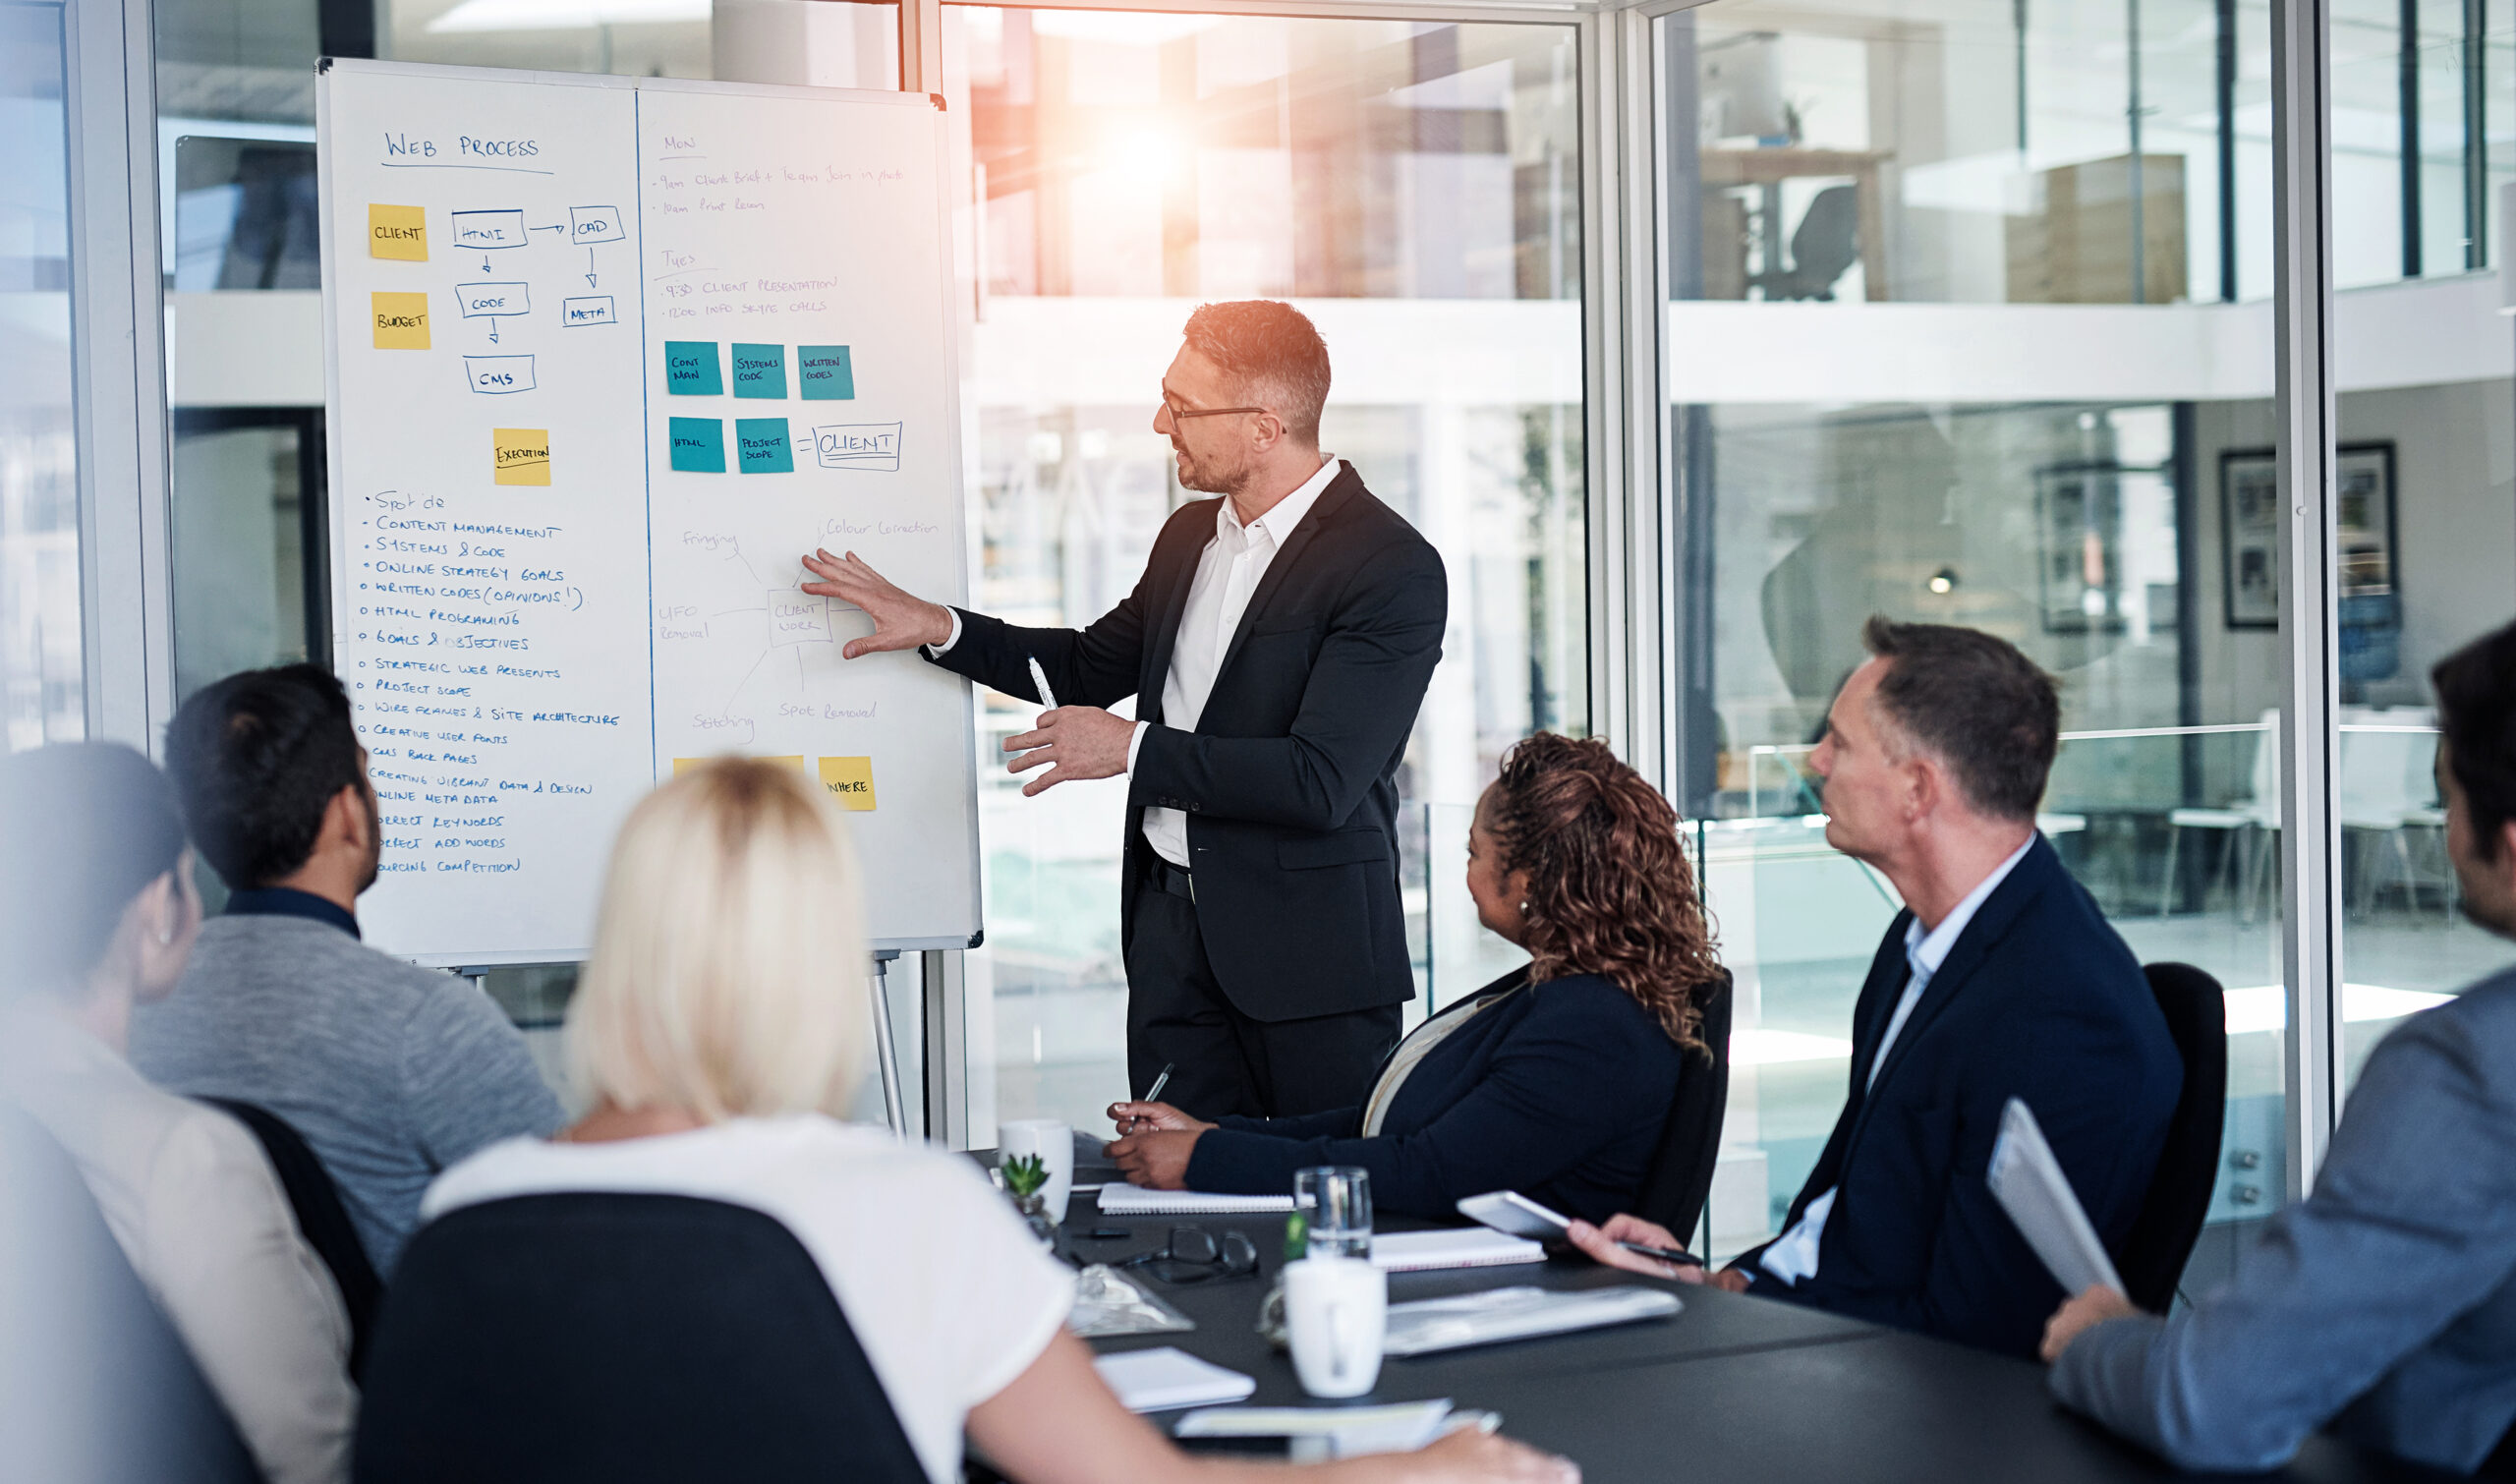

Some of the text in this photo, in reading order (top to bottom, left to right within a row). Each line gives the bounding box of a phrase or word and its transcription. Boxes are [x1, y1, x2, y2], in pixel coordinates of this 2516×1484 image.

[385, 133, 539, 157] WEB PROCESS
[374, 226, 424, 241] CLIENT
[578, 220, 607, 235] CAD
[702, 281, 749, 294] CLIENT
[758, 276, 838, 292] PRESENTATION
[472, 298, 505, 310] CODE
[742, 302, 778, 315] SKYPE
[789, 301, 828, 314] CALLS
[377, 314, 426, 328] BUDGET
[571, 308, 604, 319] META
[672, 358, 699, 368] CONT
[737, 358, 778, 370] SYSTEMS
[803, 357, 840, 368] WRITTEN
[480, 373, 513, 386] CMS
[674, 370, 700, 380] MAN
[739, 371, 764, 381] CODE
[806, 371, 832, 379] CODES
[674, 437, 706, 448] HTML
[743, 437, 783, 449] PROJECT
[820, 433, 894, 452] CLIENT
[496, 445, 549, 463] EXECUTION
[746, 450, 773, 459] SCOPE
[374, 490, 416, 511] Spot
[376, 516, 563, 539] CONTENT MANAGEMENT
[827, 519, 871, 536] Colour
[376, 538, 505, 558] SYSTEMS & CODE
[376, 561, 564, 582] ONLINE STRATEGY GOALS
[375, 582, 435, 597] WRITTEN
[374, 606, 520, 625] HTML PROGRAMING
[659, 605, 698, 620] UFO
[775, 603, 822, 617] CLIENT
[659, 622, 710, 640] Removal
[778, 622, 822, 632] WORK
[376, 629, 419, 646] GOALS
[428, 631, 438, 646] &
[375, 658, 561, 679] STRATEGIC WEB PRESENTS
[375, 679, 472, 698] PROJECT SCOPE
[375, 702, 410, 714] WIRE
[416, 706, 467, 718] FRAMES
[533, 713, 620, 726] ARCHITECTURE
[825, 701, 878, 719] Removal
[373, 724, 509, 745] CREATIVE USER FONTS
[408, 749, 437, 763] BACK
[443, 753, 478, 765] PAGES
[370, 768, 428, 785] CREATING
[437, 776, 489, 788] VIBRANT
[499, 780, 529, 792] DATA
[550, 783, 593, 795] DESIGN
[828, 780, 868, 793] WHERE
[426, 794, 458, 805] META
[464, 795, 498, 806] DATA
[378, 816, 424, 828] ORRECT
[379, 837, 506, 850] ORRECT ADD WORDS
[377, 858, 521, 874] OURCING COMPETITION
